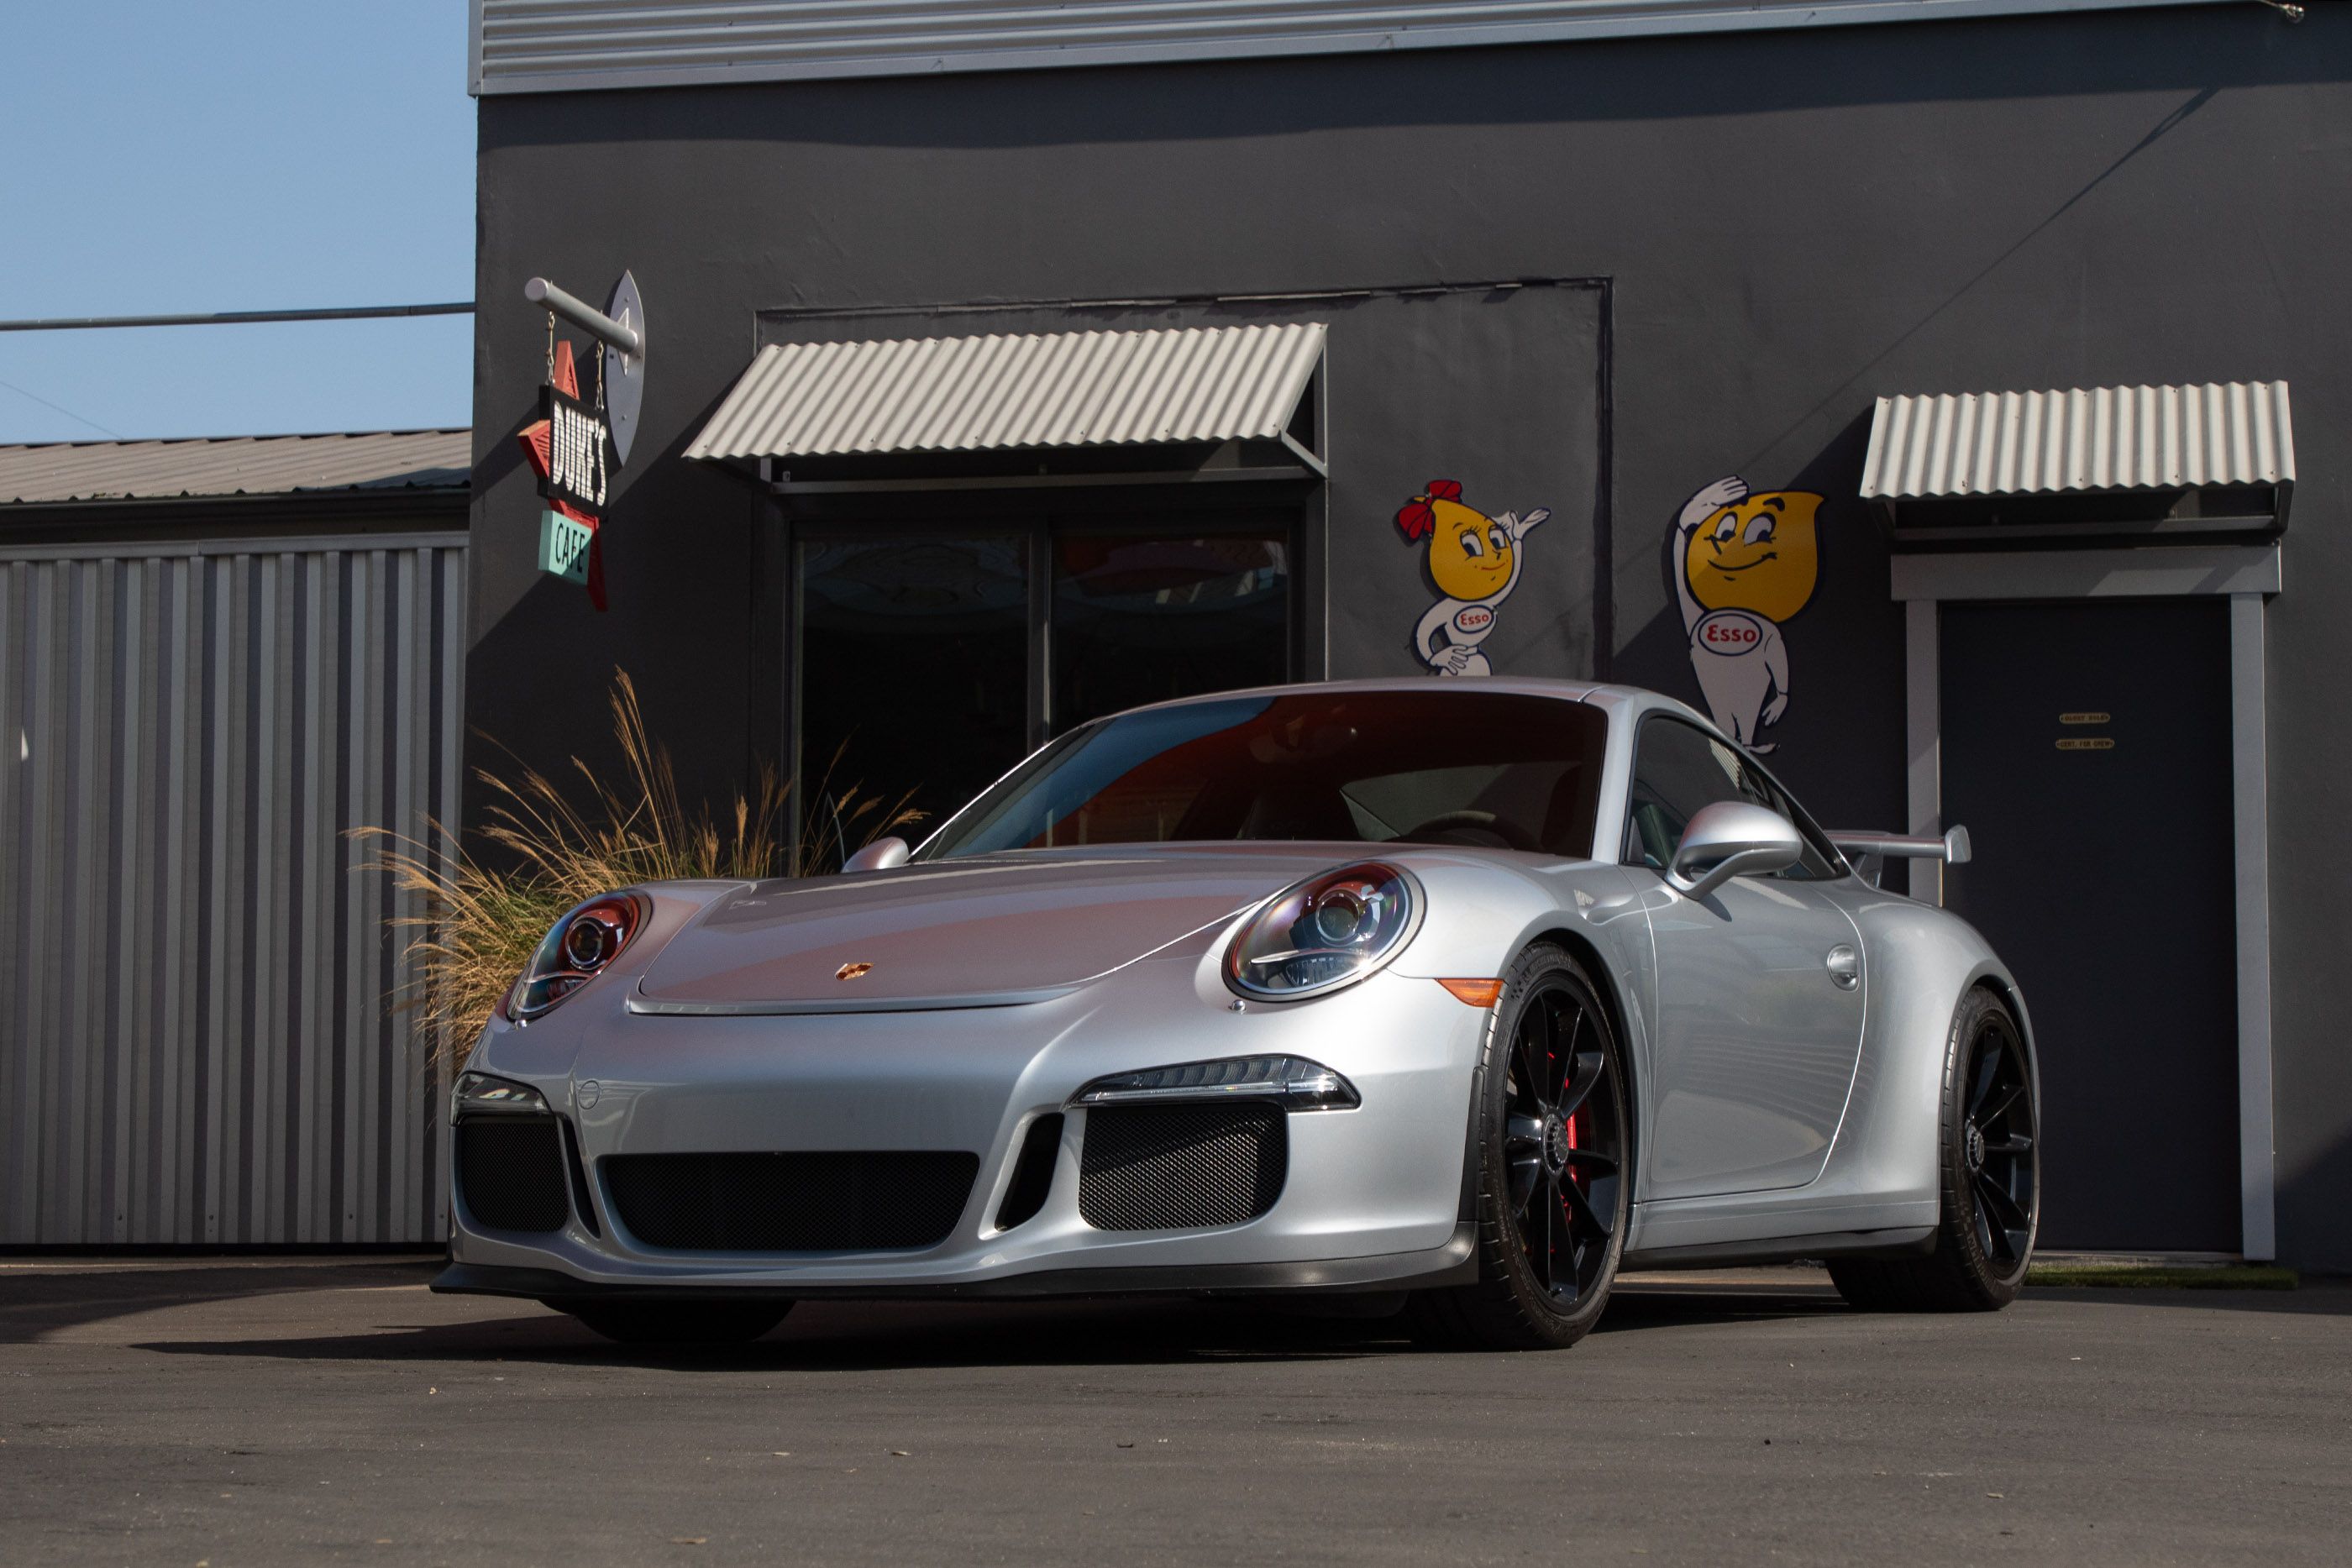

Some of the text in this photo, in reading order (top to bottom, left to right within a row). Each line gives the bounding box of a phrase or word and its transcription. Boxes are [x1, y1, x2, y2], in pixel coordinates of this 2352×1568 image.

[553, 401, 606, 506] DUKE'S
[555, 522, 585, 574] CAFE
[1460, 613, 1488, 626] Esso
[1706, 624, 1757, 642] Esso
